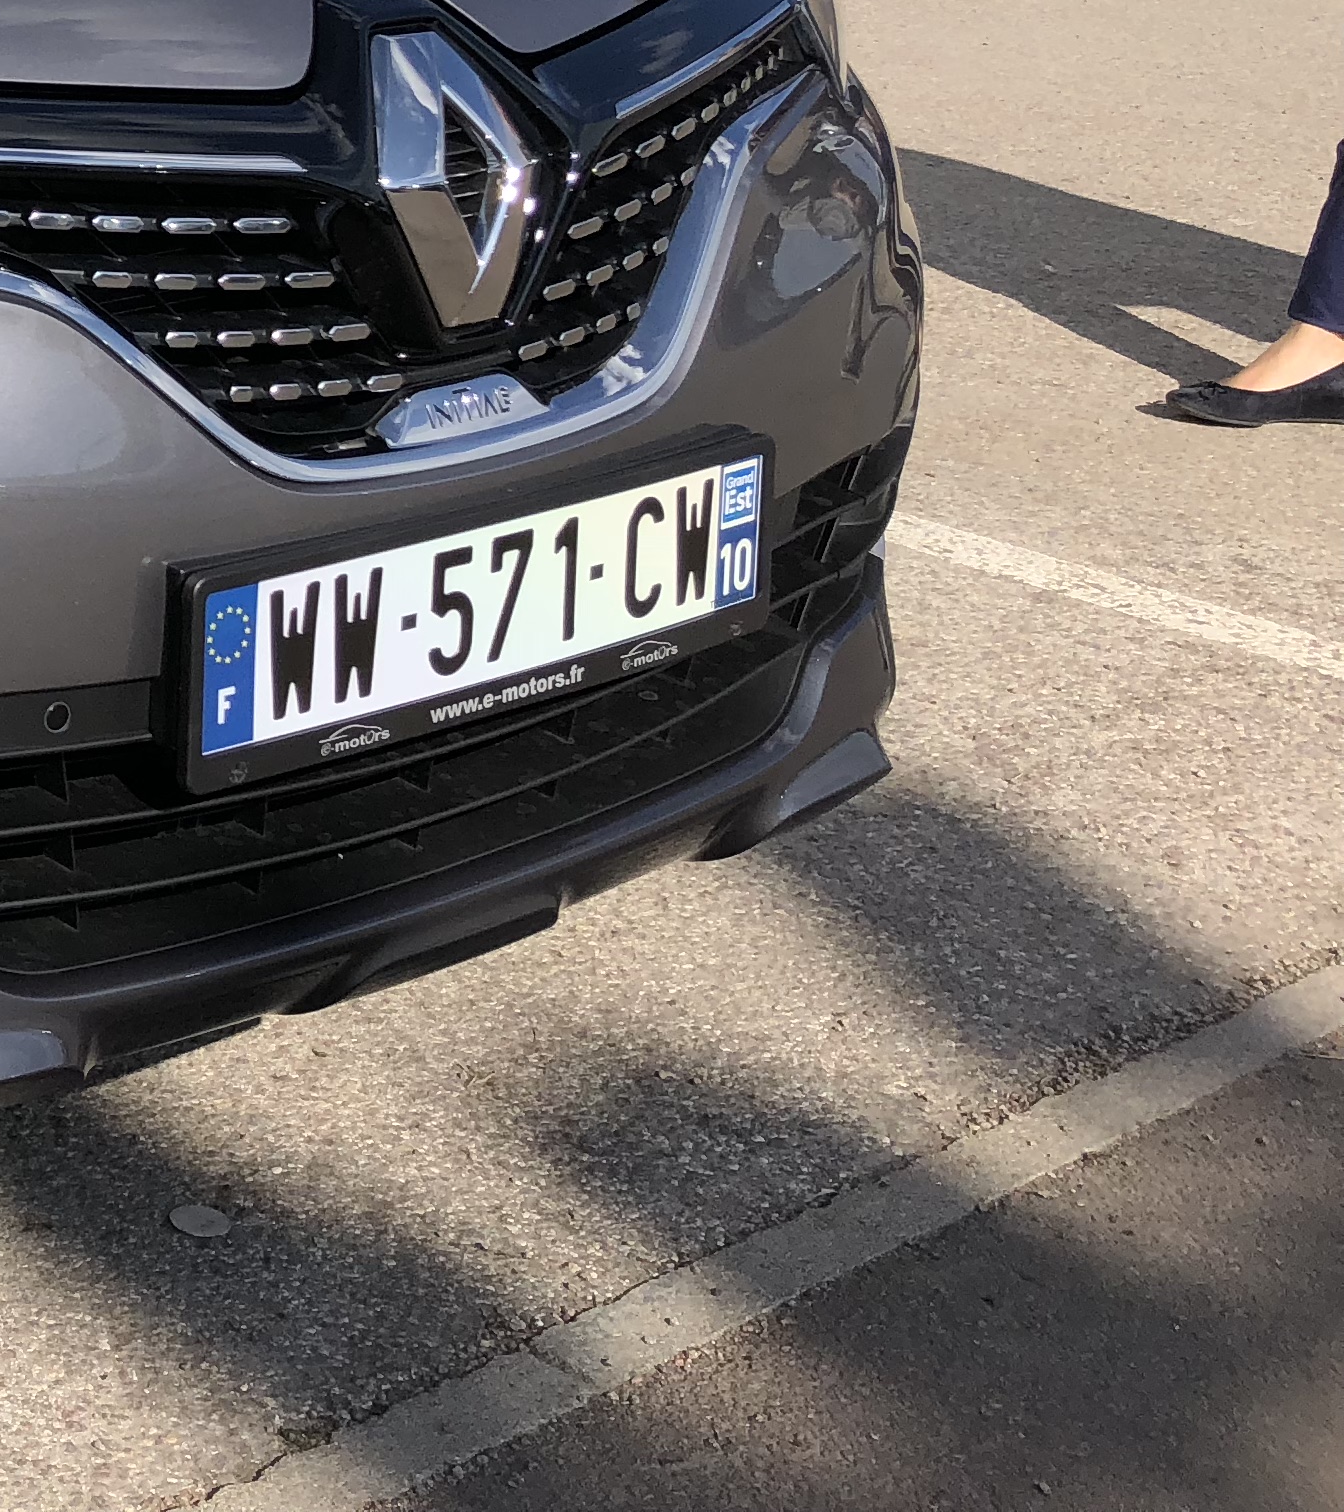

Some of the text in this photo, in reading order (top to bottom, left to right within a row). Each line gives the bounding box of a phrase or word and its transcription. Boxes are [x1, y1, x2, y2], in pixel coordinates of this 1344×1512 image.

[726, 471, 754, 489] Grand
[725, 486, 753, 515] Est
[720, 538, 752, 596] 10
[620, 645, 679, 671] e-motors
[217, 686, 236, 725] F
[430, 664, 585, 724] www.e-motors.fr
[320, 729, 391, 757] e-motors
